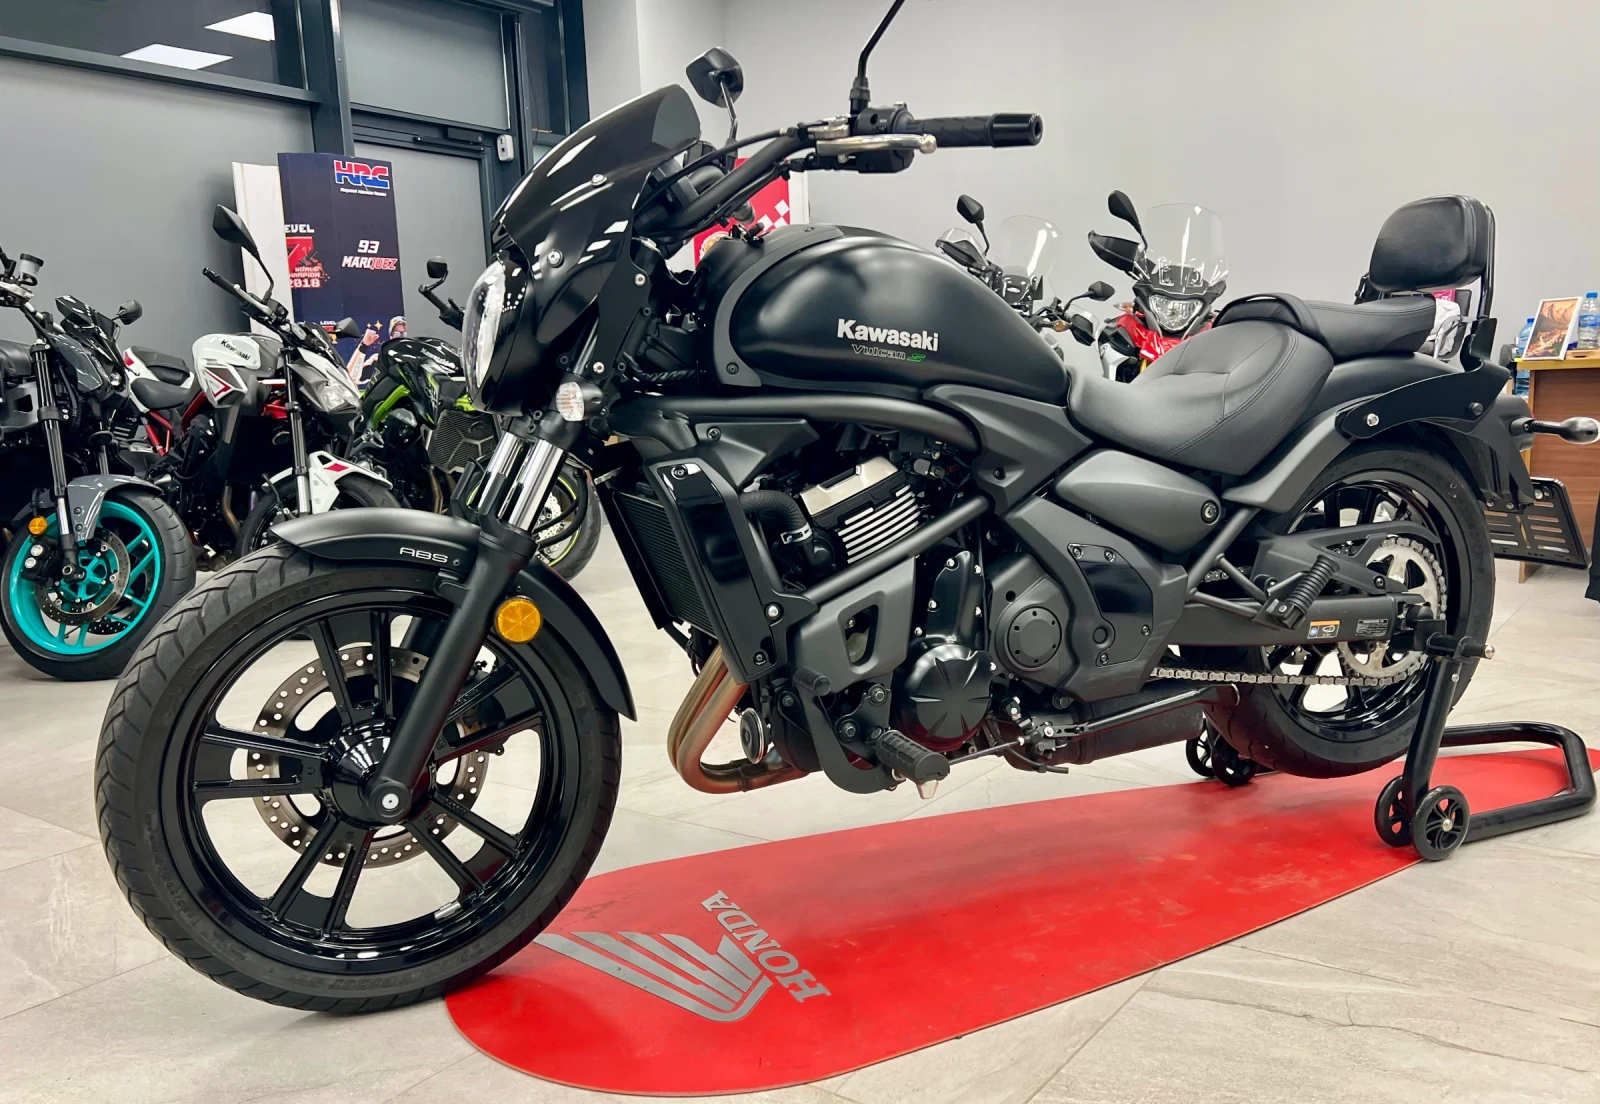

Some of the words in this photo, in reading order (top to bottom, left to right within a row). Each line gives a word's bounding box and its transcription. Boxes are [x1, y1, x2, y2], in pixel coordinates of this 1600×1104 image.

[334, 160, 390, 190] HRC
[284, 224, 315, 233] EVEL
[357, 239, 380, 254] 93
[341, 255, 398, 271] MARQUEZ
[289, 278, 321, 289] 2018
[837, 318, 939, 352] Kawasaki
[906, 352, 927, 363] S
[399, 547, 449, 563] ABS
[701, 889, 832, 1003] HONDA
